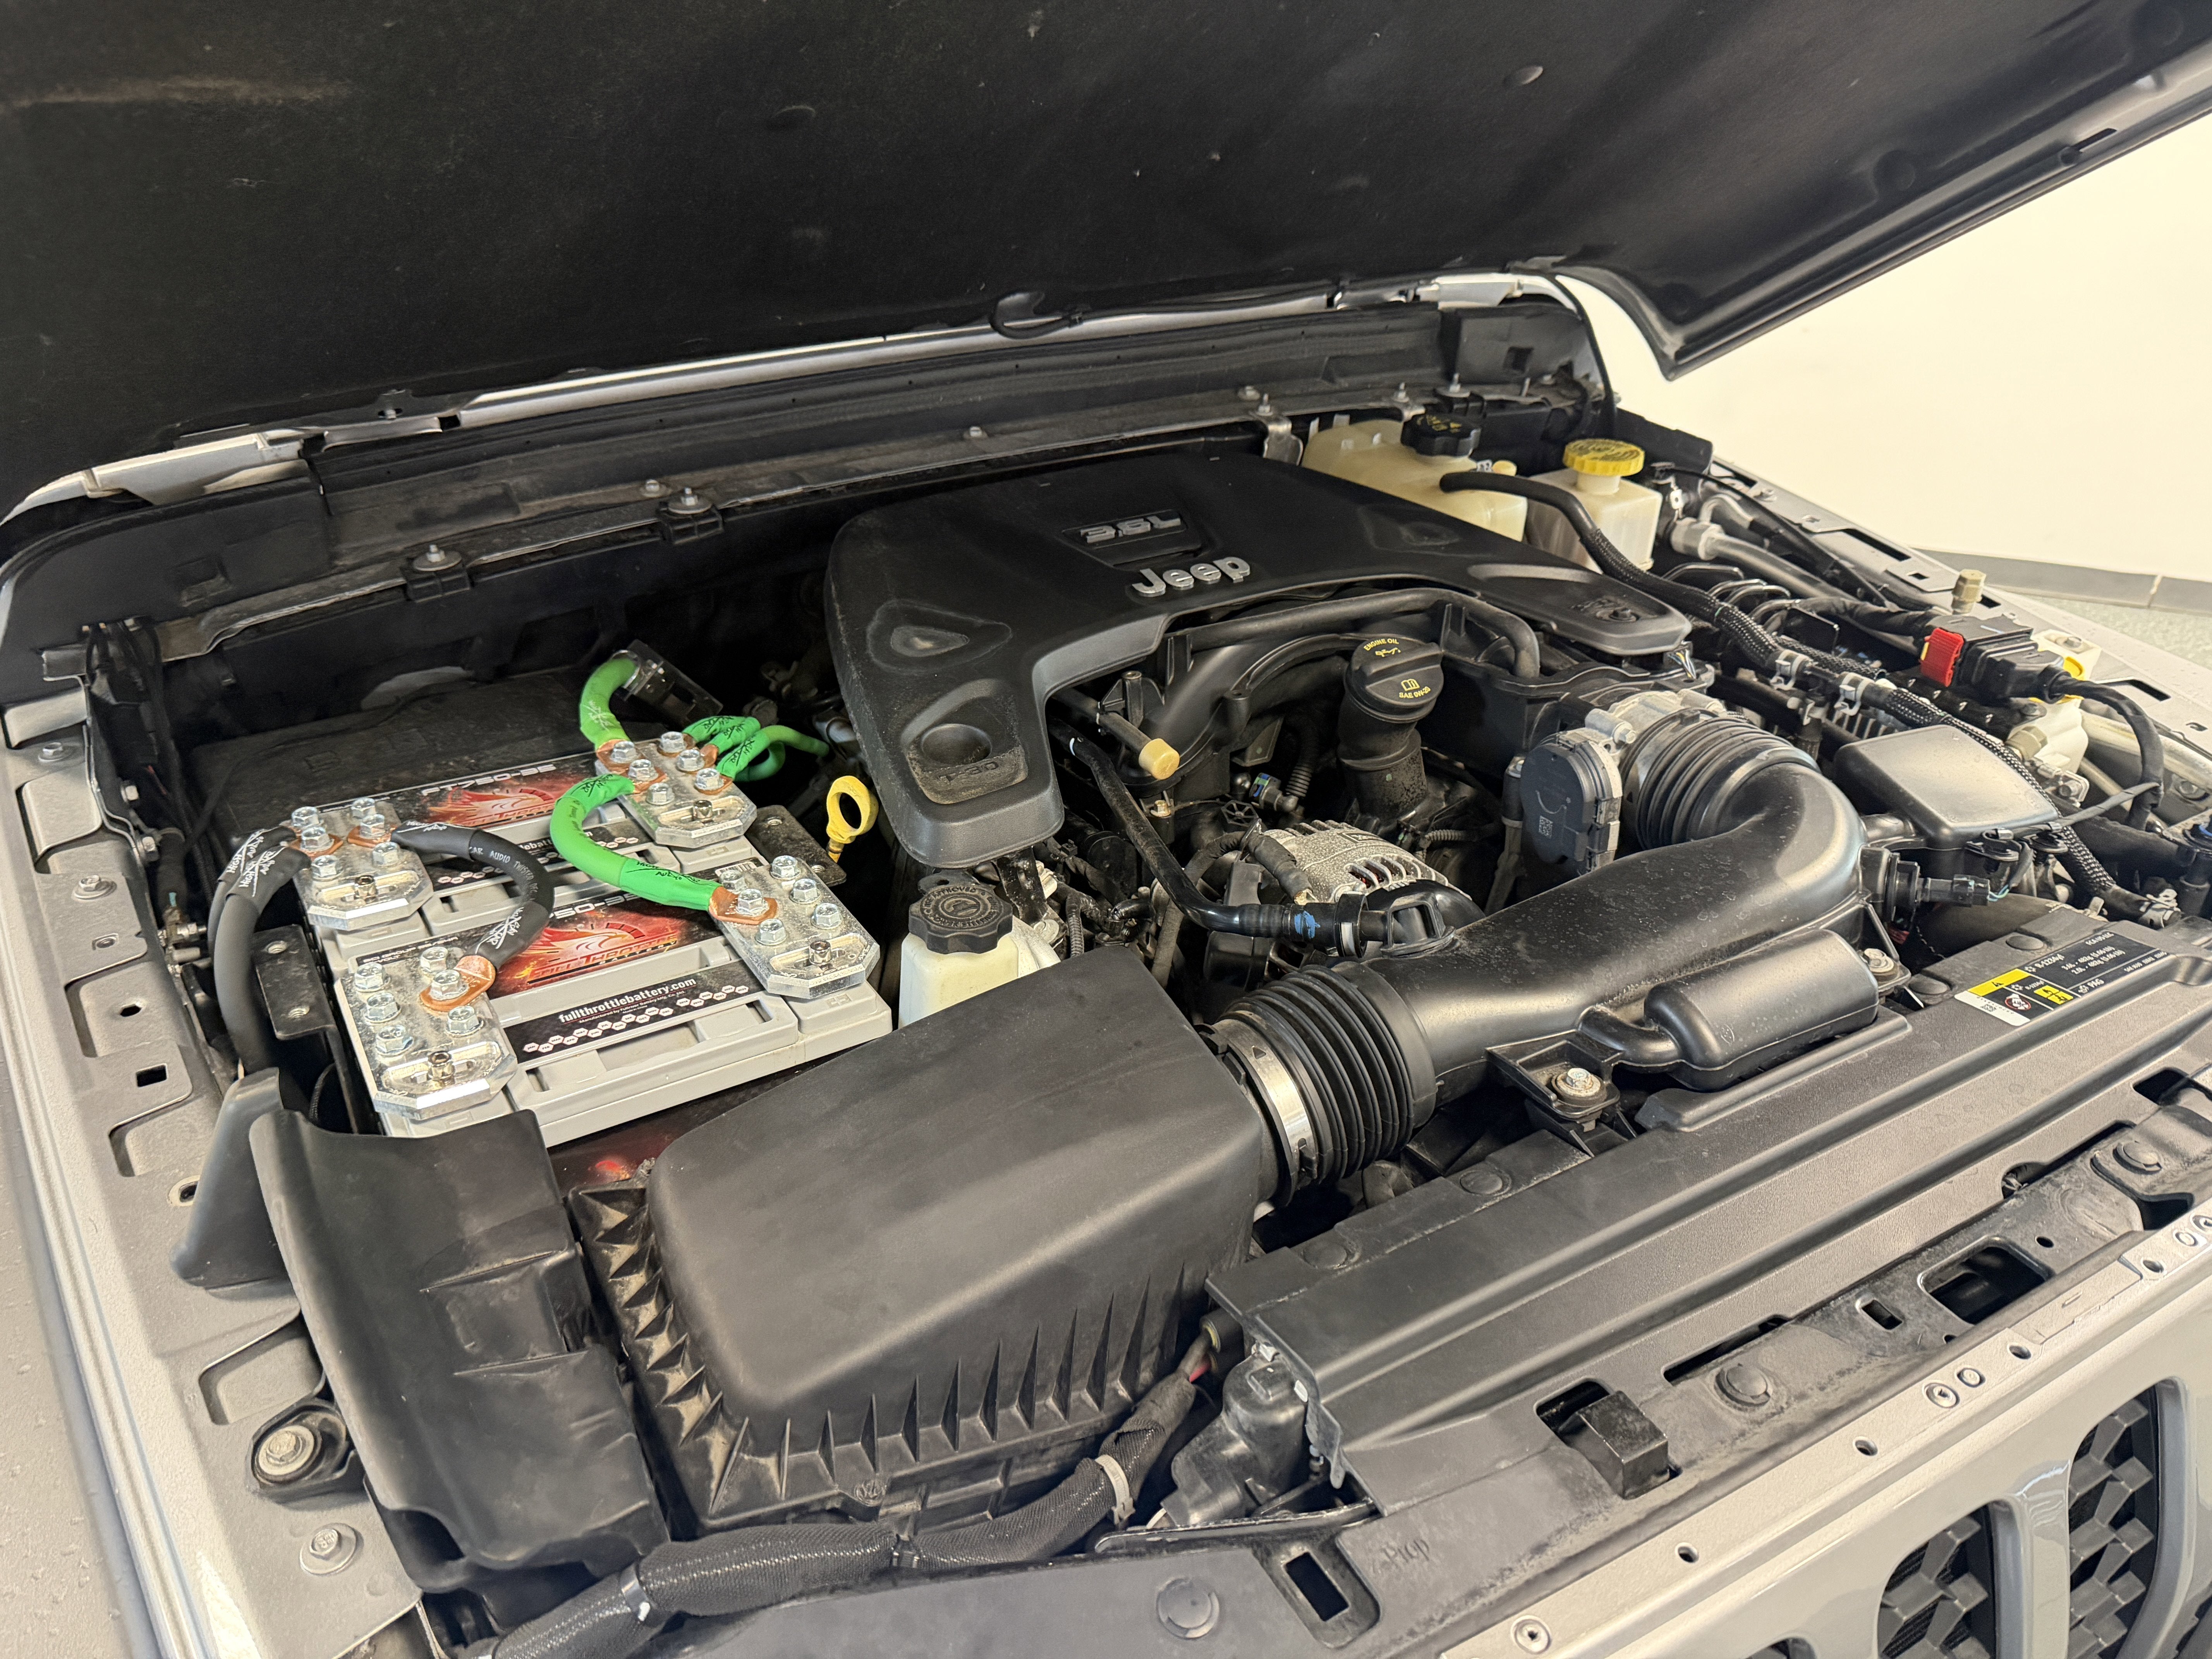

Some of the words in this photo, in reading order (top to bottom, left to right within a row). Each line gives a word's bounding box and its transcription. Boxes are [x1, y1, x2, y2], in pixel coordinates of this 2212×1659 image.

[1080, 516, 1181, 543] 3.6L
[1132, 556, 1250, 598] Jeep
[1364, 639, 1387, 651] ENGINE
[1413, 686, 1431, 698] 0W-20
[489, 850, 511, 863] AUDIO
[2087, 978, 2104, 988] PAG
[559, 979, 697, 1023] fullthrottlebattery.com
[579, 1012, 613, 1023] Manufactured
